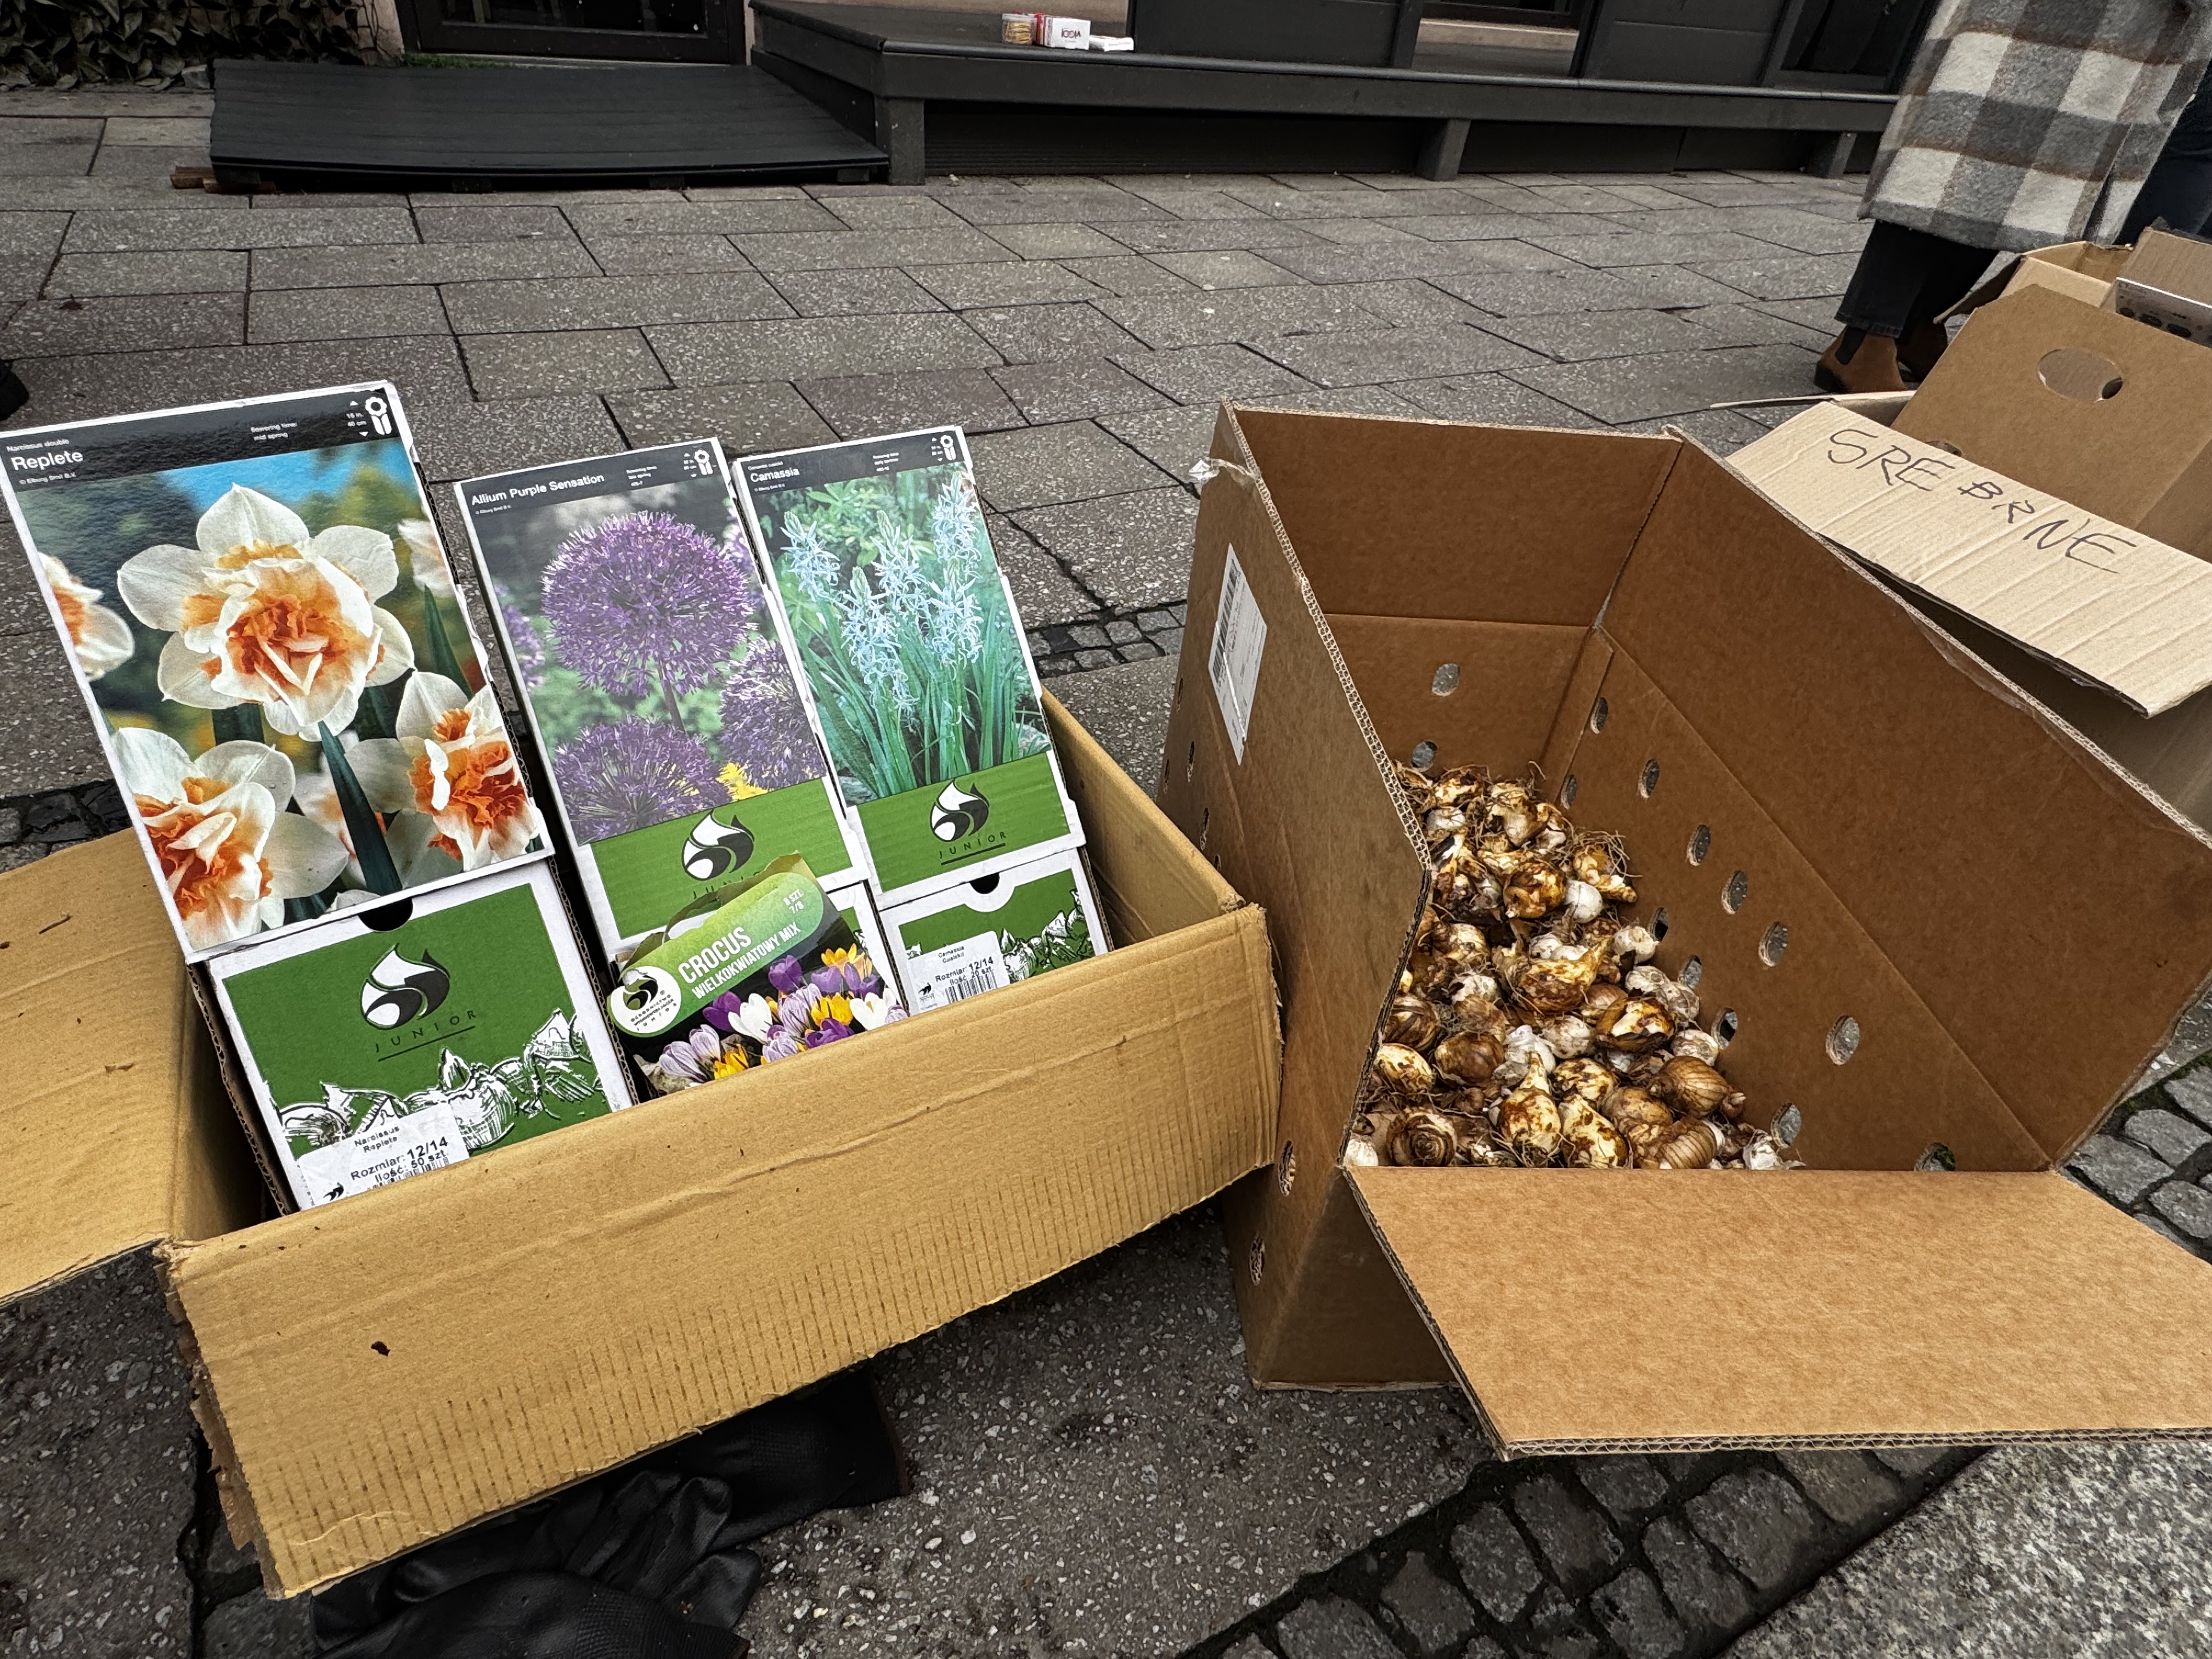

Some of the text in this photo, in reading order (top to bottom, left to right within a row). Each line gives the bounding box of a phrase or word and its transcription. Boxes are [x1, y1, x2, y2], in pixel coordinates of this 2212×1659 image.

[11, 450, 83, 470] Replete
[751, 467, 800, 482] Camassia
[472, 475, 605, 506] Allium Purple Sensation
[939, 831, 1006, 859] JUNIOR
[678, 927, 752, 984] CROCUS
[691, 921, 802, 1000] WIELKOKWIATOWY MIX
[969, 956, 994, 971] 12/14
[375, 1011, 476, 1053] JUNIOR
[354, 1126, 400, 1147] Narcissus
[363, 1136, 397, 1153] Replete
[351, 1136, 448, 1180] Rozmiar: 12/14
[411, 1158, 425, 1169] 50
[428, 1149, 449, 1162] szt.
